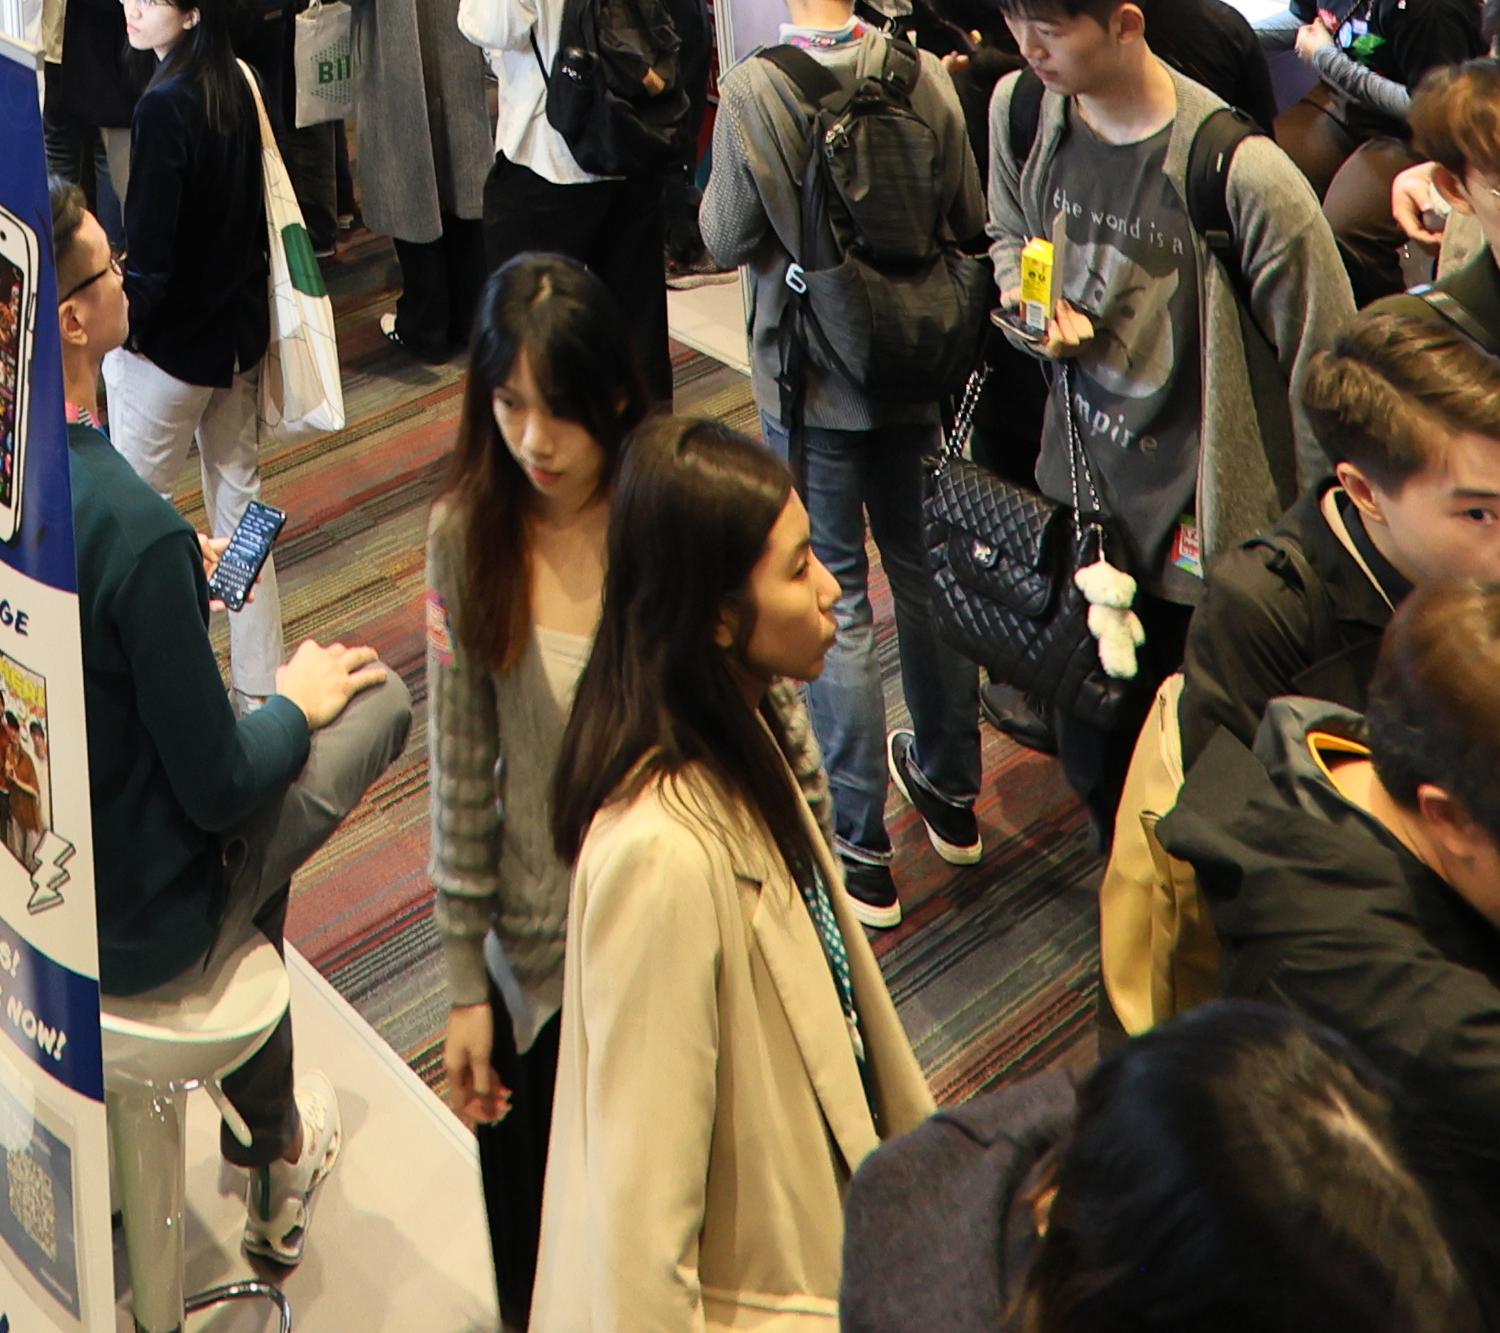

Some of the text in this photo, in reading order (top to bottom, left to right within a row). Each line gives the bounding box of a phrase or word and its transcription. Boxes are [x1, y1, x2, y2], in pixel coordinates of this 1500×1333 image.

[1053, 187, 1164, 248] the is
[1074, 392, 1158, 453] mpire
[7, 992, 68, 1062] NOW!
